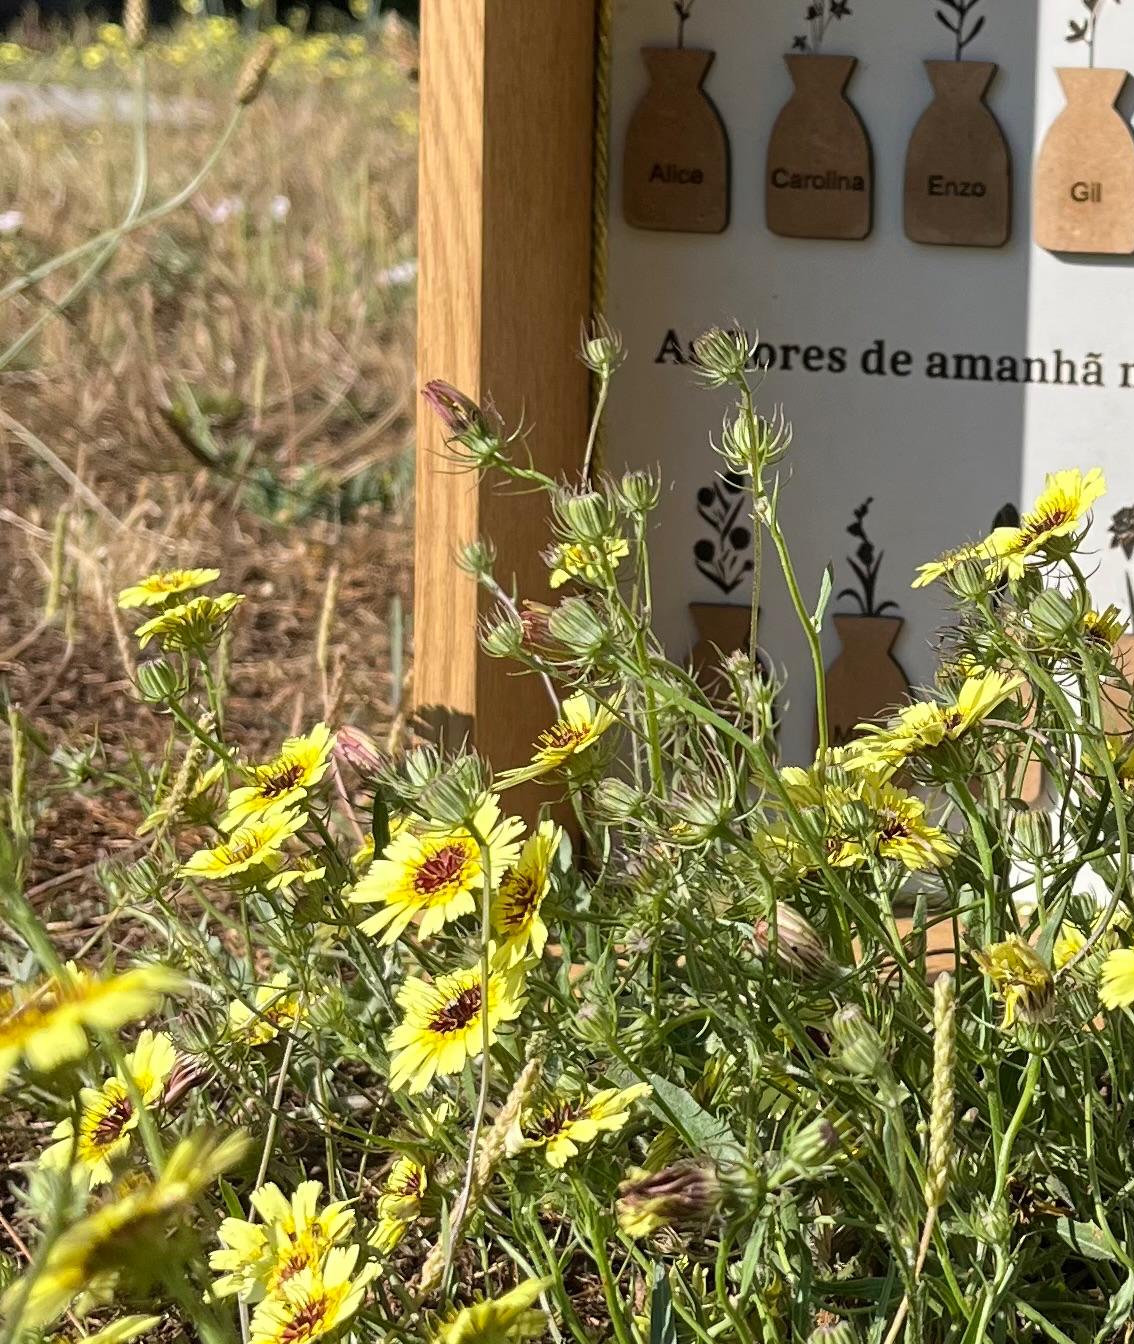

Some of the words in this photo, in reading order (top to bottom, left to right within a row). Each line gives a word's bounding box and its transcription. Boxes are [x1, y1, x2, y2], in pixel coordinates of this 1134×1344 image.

[647, 161, 704, 185] Alice
[771, 167, 865, 193] Carolina
[927, 174, 986, 198] Enzo
[1069, 181, 1102, 205] Gil
[861, 340, 912, 376] de
[926, 348, 1105, 386] amanhã
